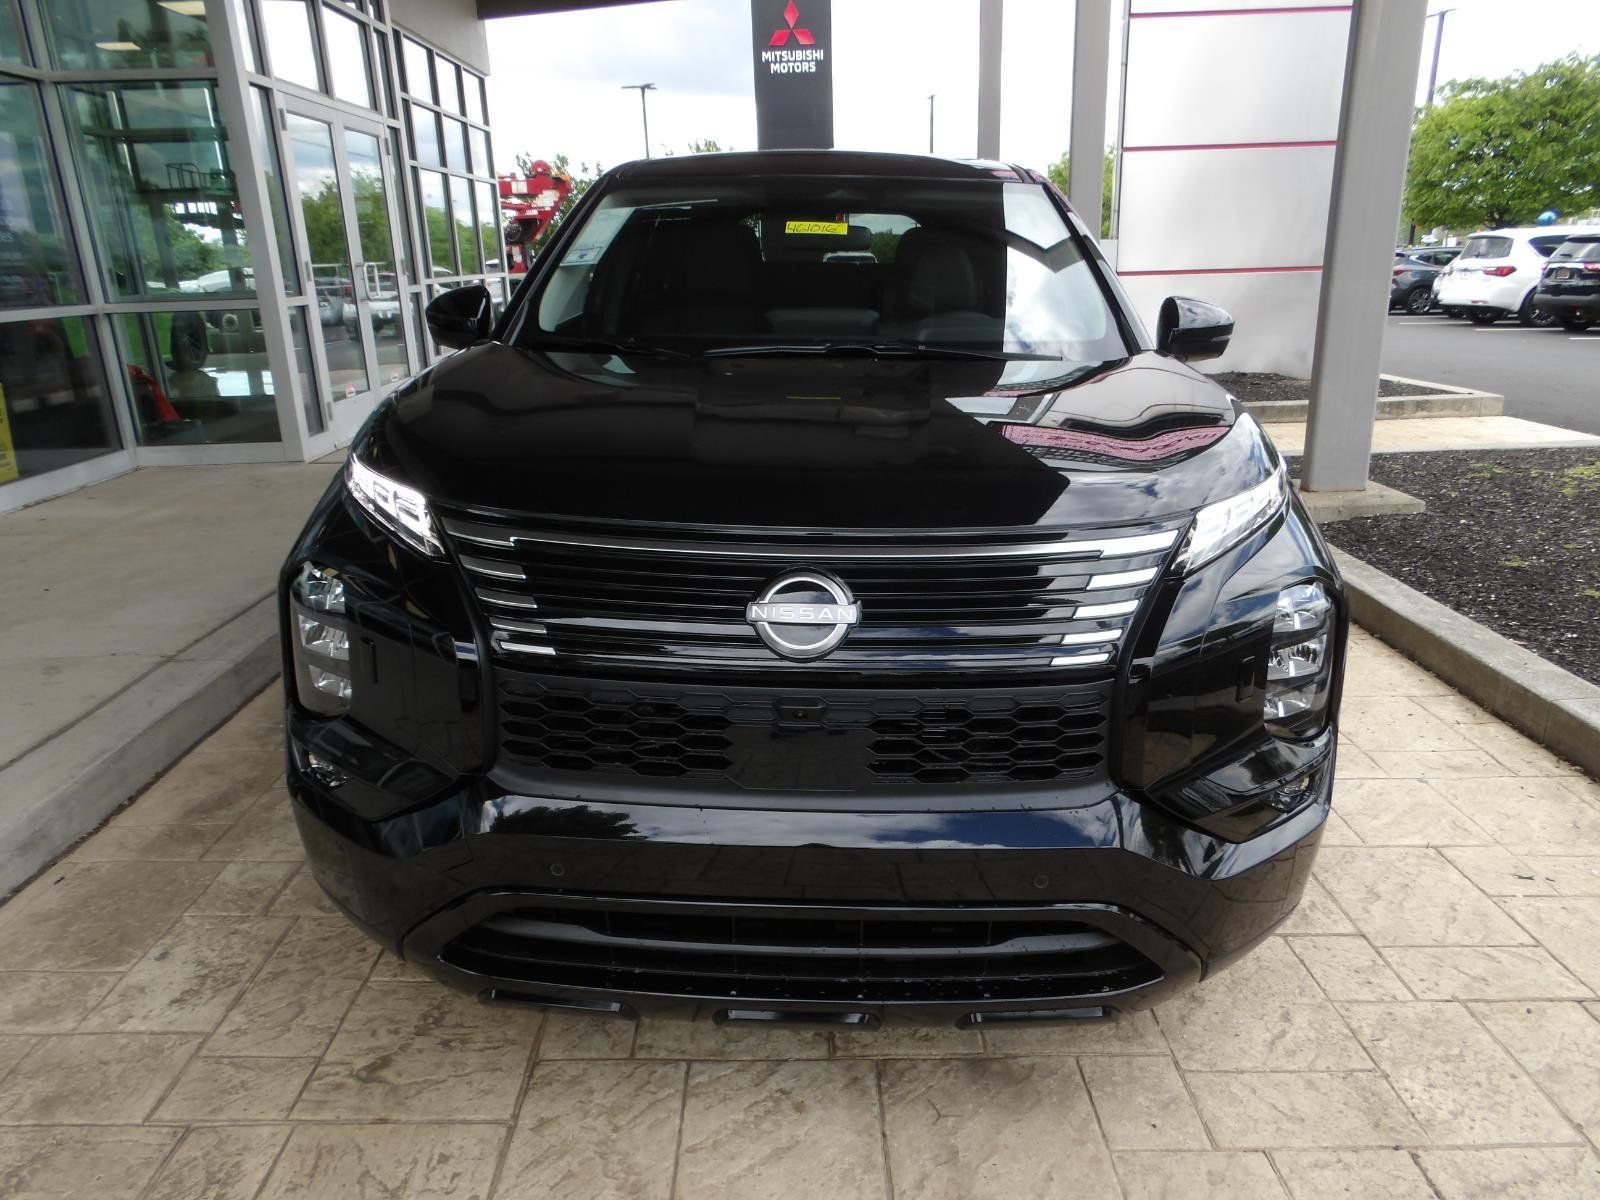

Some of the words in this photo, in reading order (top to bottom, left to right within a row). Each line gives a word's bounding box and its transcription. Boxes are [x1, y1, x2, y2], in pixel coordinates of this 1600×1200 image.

[761, 49, 824, 62] MITSUBISHI
[770, 61, 816, 74] MOTORS
[751, 605, 853, 620] NISSAN
